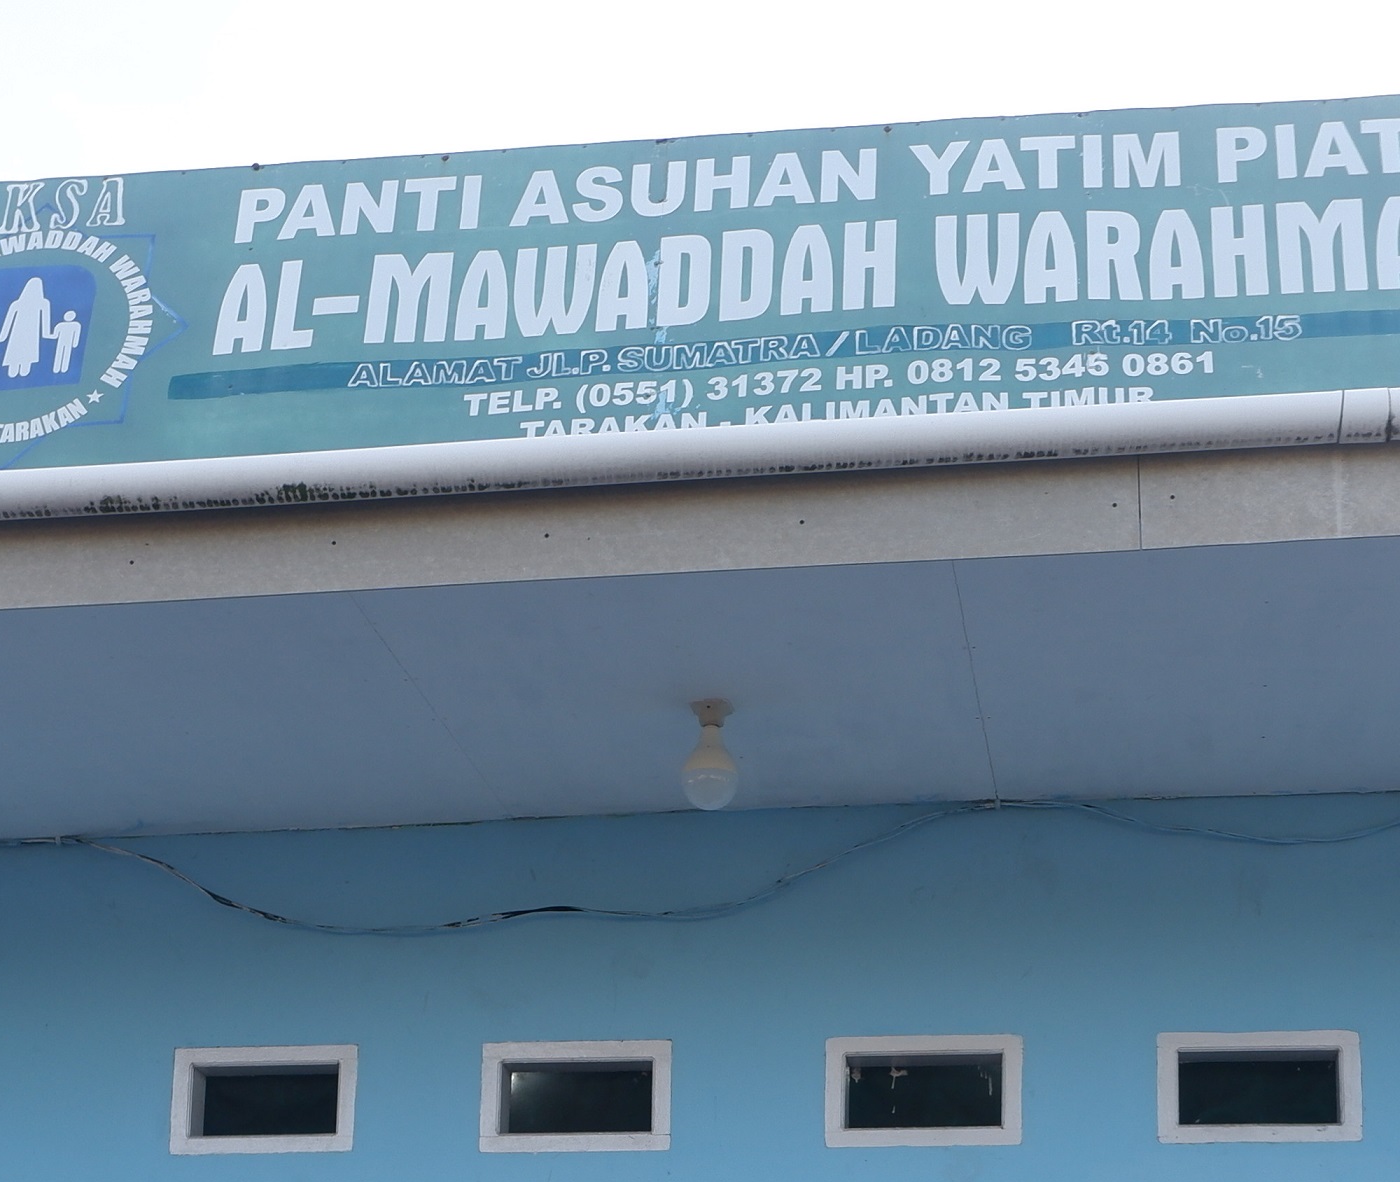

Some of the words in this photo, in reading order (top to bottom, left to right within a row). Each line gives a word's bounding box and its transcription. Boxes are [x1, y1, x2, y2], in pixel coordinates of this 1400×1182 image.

[234, 174, 482, 244] PANTI
[509, 147, 877, 227] ASUHAN
[909, 131, 1181, 195] YATIM
[100, 254, 153, 389] WARAHMAH
[212, 219, 897, 356] AL-MAWADDAH
[348, 356, 522, 387] ALAMAT
[1072, 319, 1172, 346] Rt.14
[1190, 315, 1302, 344] No.15
[463, 388, 562, 416] TELP.
[576, 379, 694, 413] (0551)
[706, 368, 822, 401] 31372
[835, 364, 893, 390] HP.
[907, 358, 1001, 385] 0812
[1122, 351, 1215, 376] 0861
[519, 411, 707, 438] TARAKAN
[745, 392, 1008, 425] KALIMANTAN
[1022, 387, 1154, 408] TIMUR
